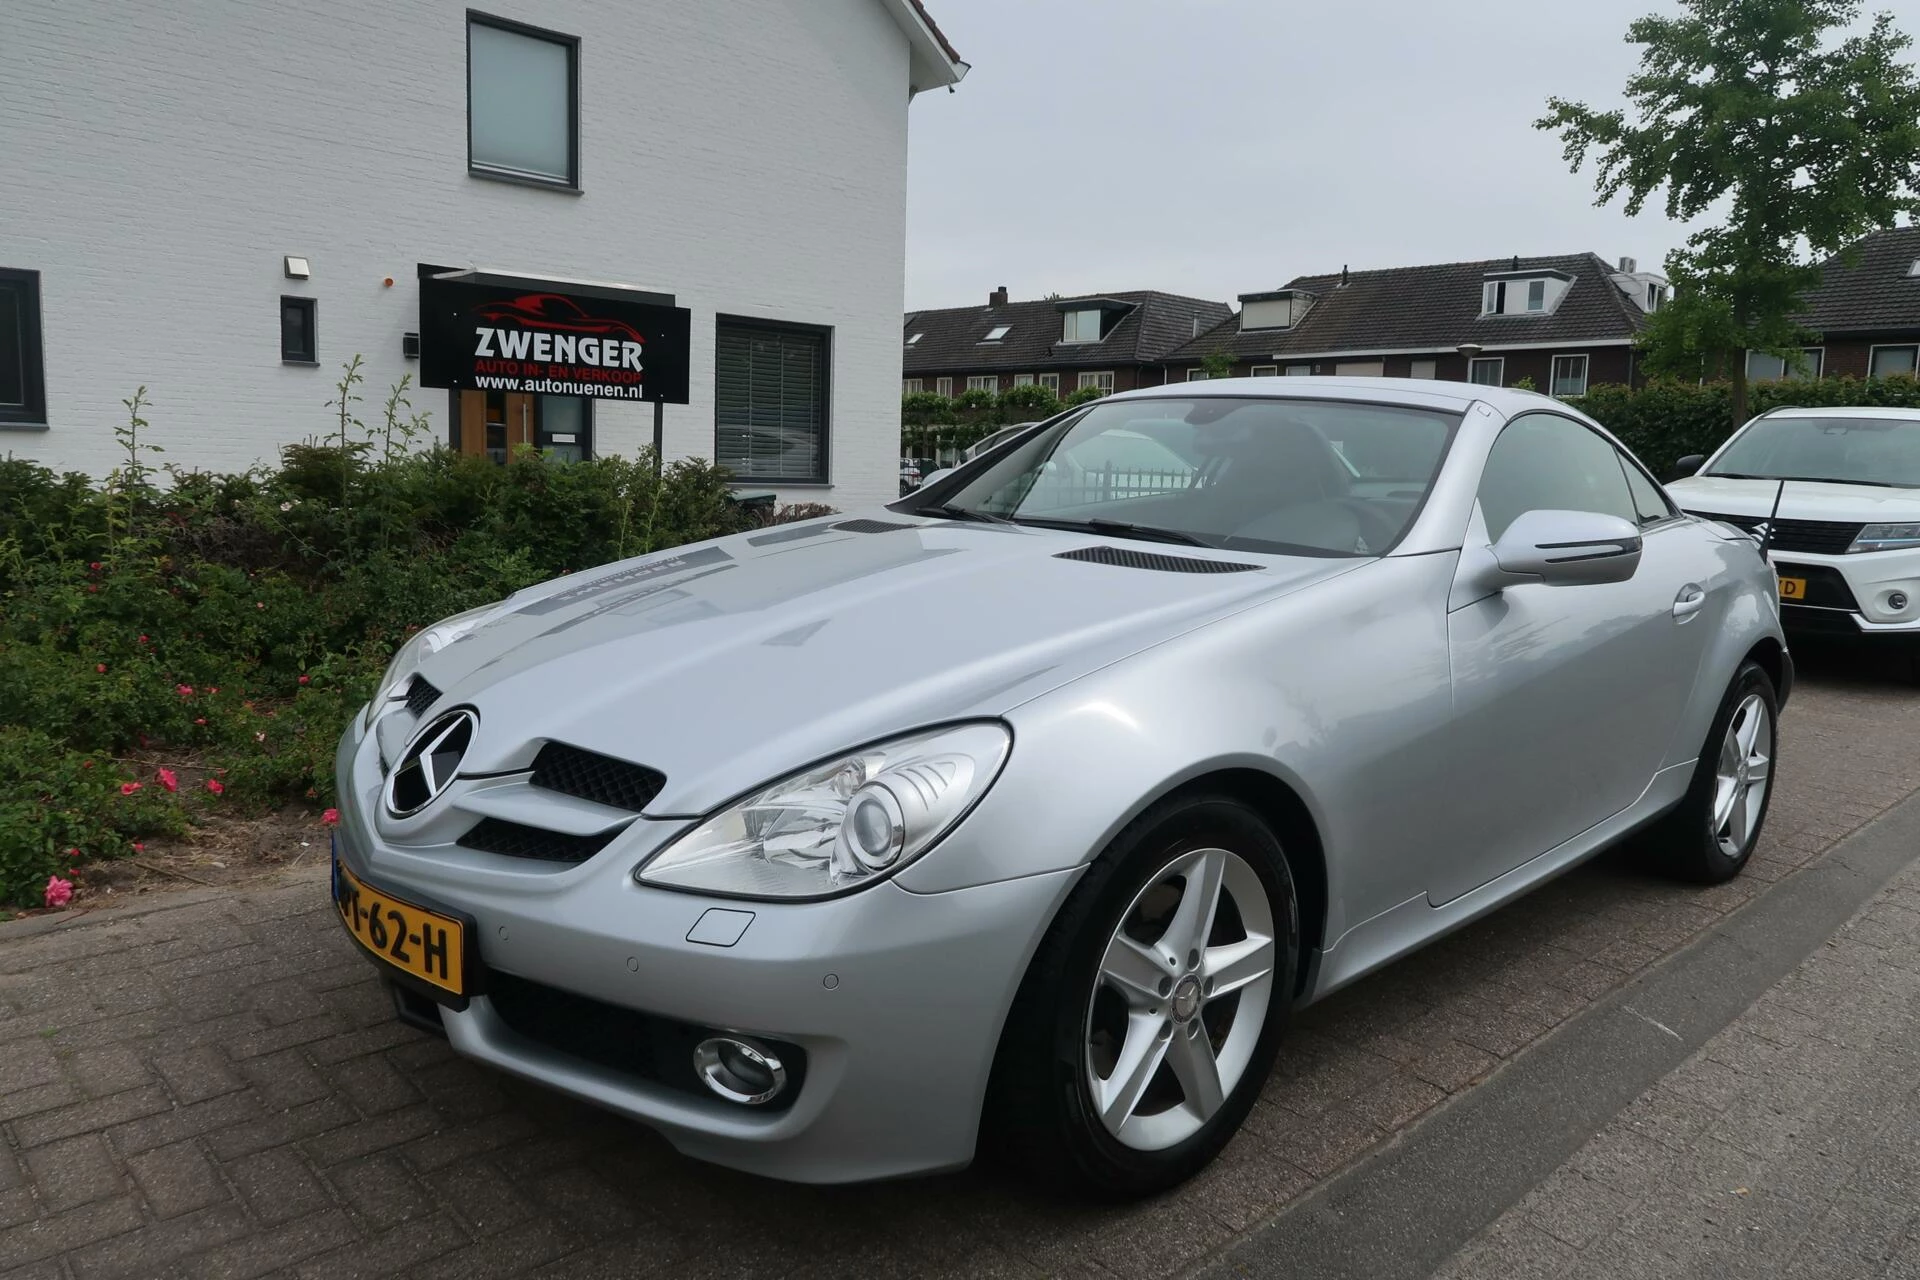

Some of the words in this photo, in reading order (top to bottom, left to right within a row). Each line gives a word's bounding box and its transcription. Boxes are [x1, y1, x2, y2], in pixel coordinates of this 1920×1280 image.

[475, 327, 644, 372] ZWENGER
[475, 359, 518, 376] AUTO
[523, 363, 545, 377] IN-
[549, 366, 569, 379] EN
[572, 368, 642, 384] VERKOOP
[475, 376, 643, 399] www.autonuenen.nl
